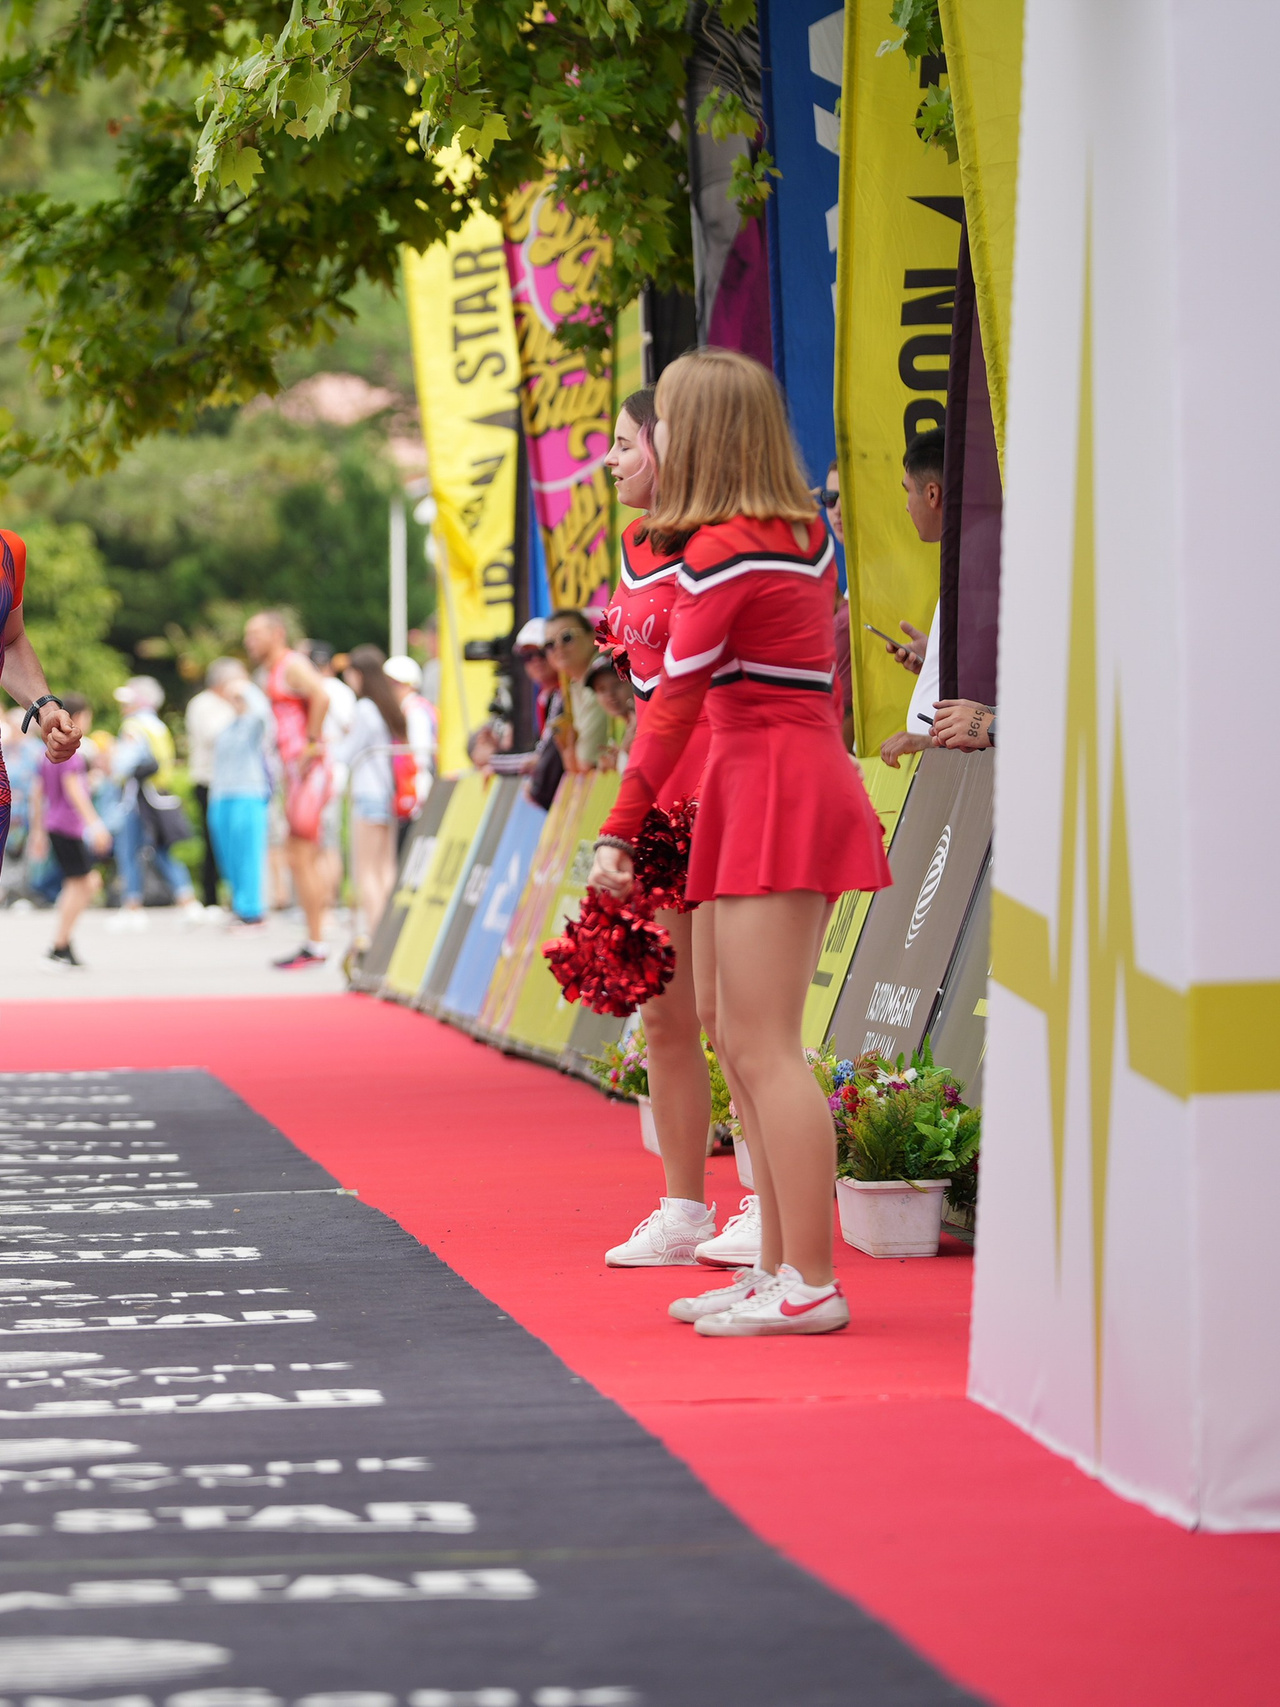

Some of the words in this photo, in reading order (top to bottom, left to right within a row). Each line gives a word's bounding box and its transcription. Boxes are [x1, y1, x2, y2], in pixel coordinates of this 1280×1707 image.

[453, 244, 508, 385] STAR
[967, 709, 985, 737] 5198
[14, 1309, 317, 1329] STAR
[31, 1389, 384, 1411] STAR
[54, 1502, 475, 1533] STAR
[69, 1568, 537, 1600] STAR
